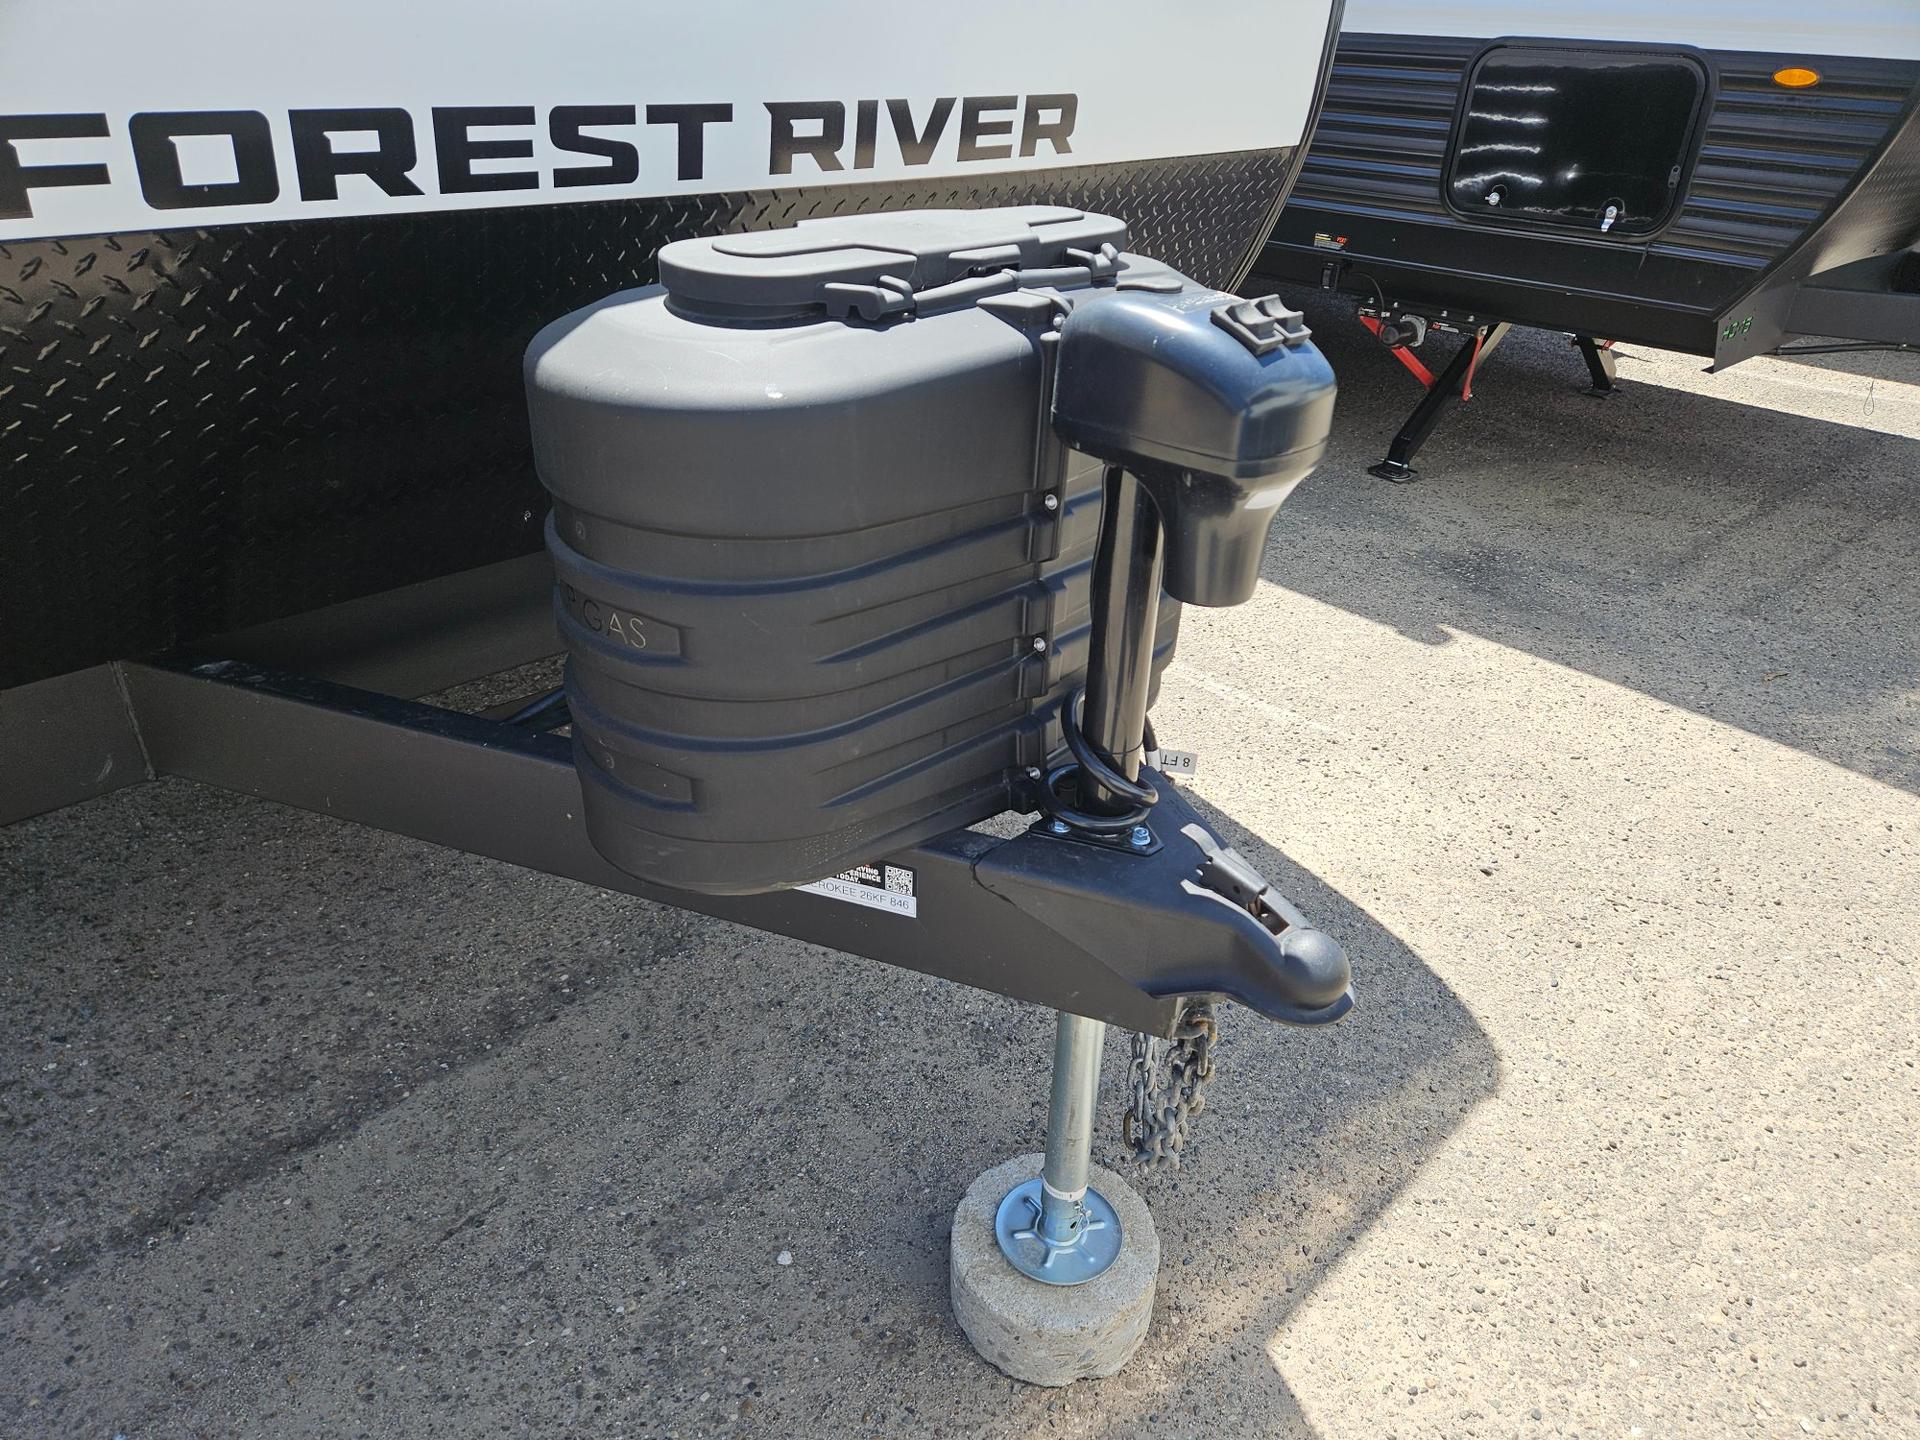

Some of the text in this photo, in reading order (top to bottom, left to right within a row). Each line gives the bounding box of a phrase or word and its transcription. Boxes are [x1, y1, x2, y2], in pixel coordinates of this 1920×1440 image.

[0, 93, 1078, 220] FOREST RIVER
[583, 600, 646, 649] GAS
[1161, 754, 1191, 767] 8 FT
[860, 890, 887, 903] 26KF
[890, 897, 909, 909] 846
